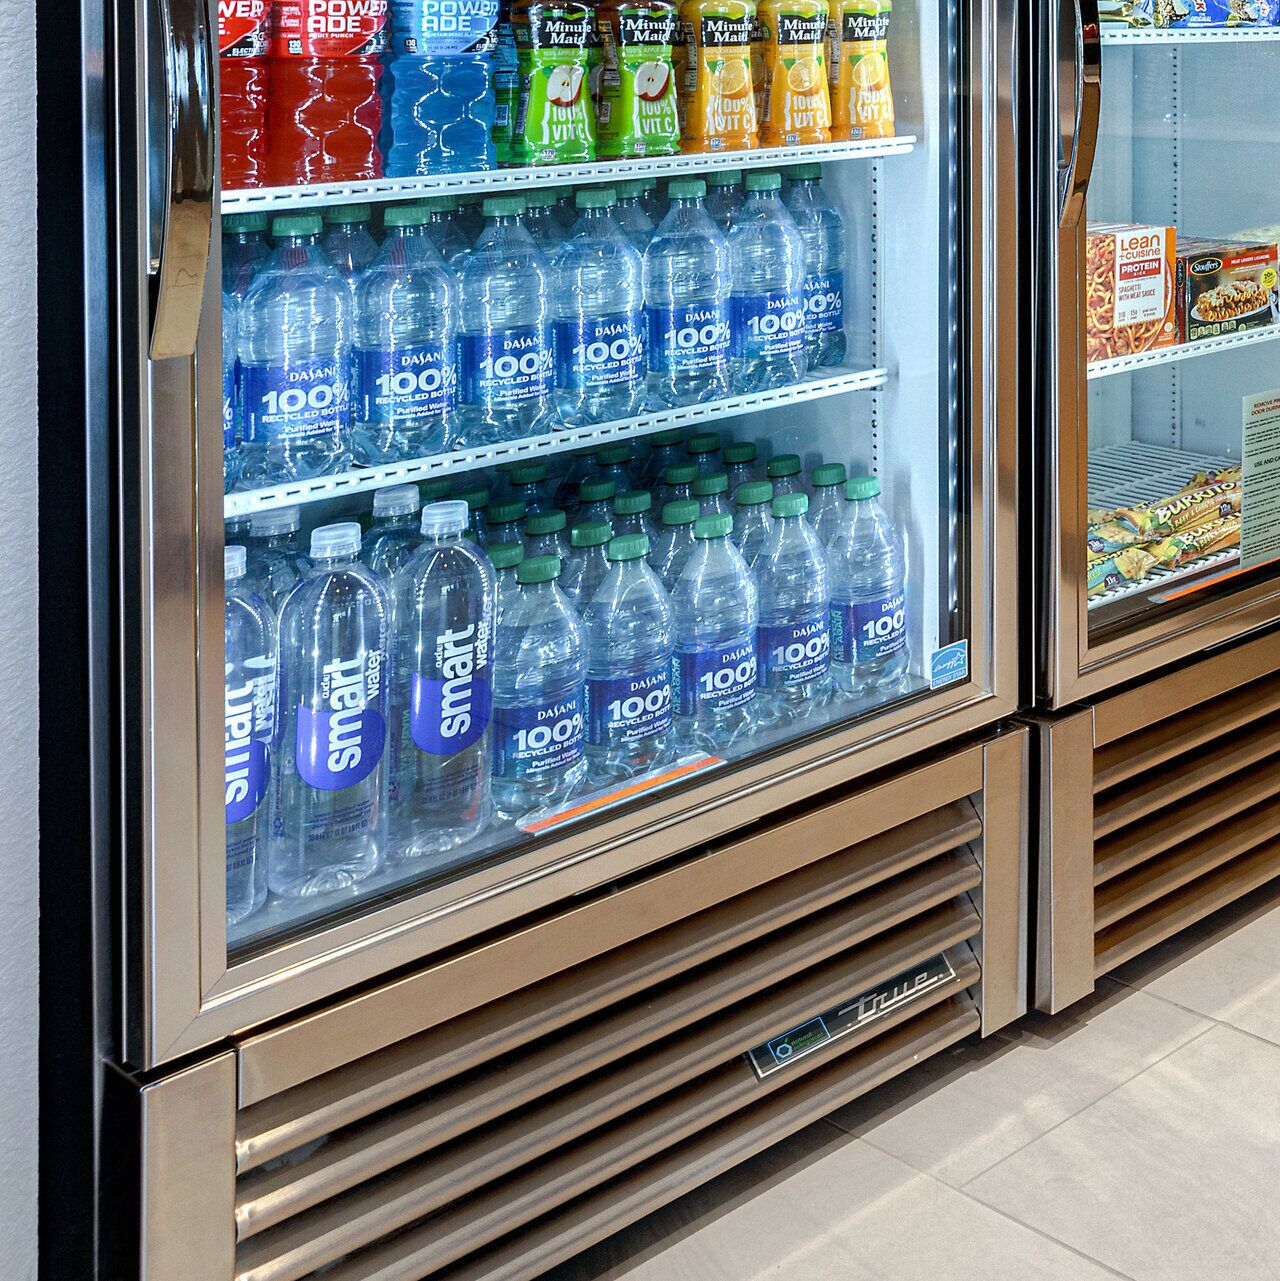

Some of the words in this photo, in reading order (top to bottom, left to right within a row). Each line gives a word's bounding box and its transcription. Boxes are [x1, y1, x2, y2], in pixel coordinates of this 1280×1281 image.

[309, 0, 388, 17] POWER
[422, 0, 499, 17] POWER
[308, 17, 362, 33] ADE
[422, 16, 473, 32] ADE
[545, 20, 592, 33] Minute
[626, 19, 675, 32] Minute
[707, 20, 752, 32] Minute
[783, 19, 826, 30] Minute
[848, 16, 889, 27] Minute
[550, 32, 586, 44] Maid
[633, 31, 670, 42] Maid
[714, 31, 748, 43] Maid
[789, 29, 821, 41] Maid
[853, 26, 886, 38] Maid
[1121, 234, 1161, 251] Lean
[1126, 247, 1161, 260] cuisine
[1121, 260, 1159, 274] PROTEIN
[1193, 260, 1219, 272] Stouffer's
[1119, 283, 1141, 293] SPAGHETTI
[1130, 291, 1141, 299] MEAT
[1142, 289, 1155, 298] SAUCE
[747, 309, 805, 335] 100%
[664, 320, 731, 349] 100%
[747, 332, 788, 344] RECYCLED
[572, 334, 643, 366] 100%
[664, 346, 708, 357] RECYCLED
[401, 351, 444, 366] DASANI
[479, 348, 553, 379] 100%
[573, 360, 619, 372] RECYCLED
[290, 367, 337, 382] DASANI
[375, 363, 457, 395] 100%
[479, 375, 529, 387] RECYCLED
[262, 382, 349, 414] 100%
[375, 391, 429, 405] RECYCLED
[1253, 397, 1273, 409] REMOVE
[262, 408, 318, 423] RECYCLED
[1251, 407, 1265, 415] DOOR
[1254, 460, 1263, 468] USE
[1155, 482, 1236, 525] BURRITO
[1174, 515, 1190, 528] BEEF
[793, 621, 824, 638] DASANI
[475, 618, 489, 670] water
[367, 649, 382, 701] water
[436, 624, 475, 738] smart
[789, 669, 813, 681] Purified
[932, 674, 951, 687] ENERGY
[950, 670, 966, 681] STAR
[718, 694, 742, 708] Purified
[328, 656, 368, 773] smart
[537, 700, 576, 721] DASANI
[626, 723, 652, 737] Purified
[532, 753, 560, 767] Purified
[838, 971, 938, 1022] true
